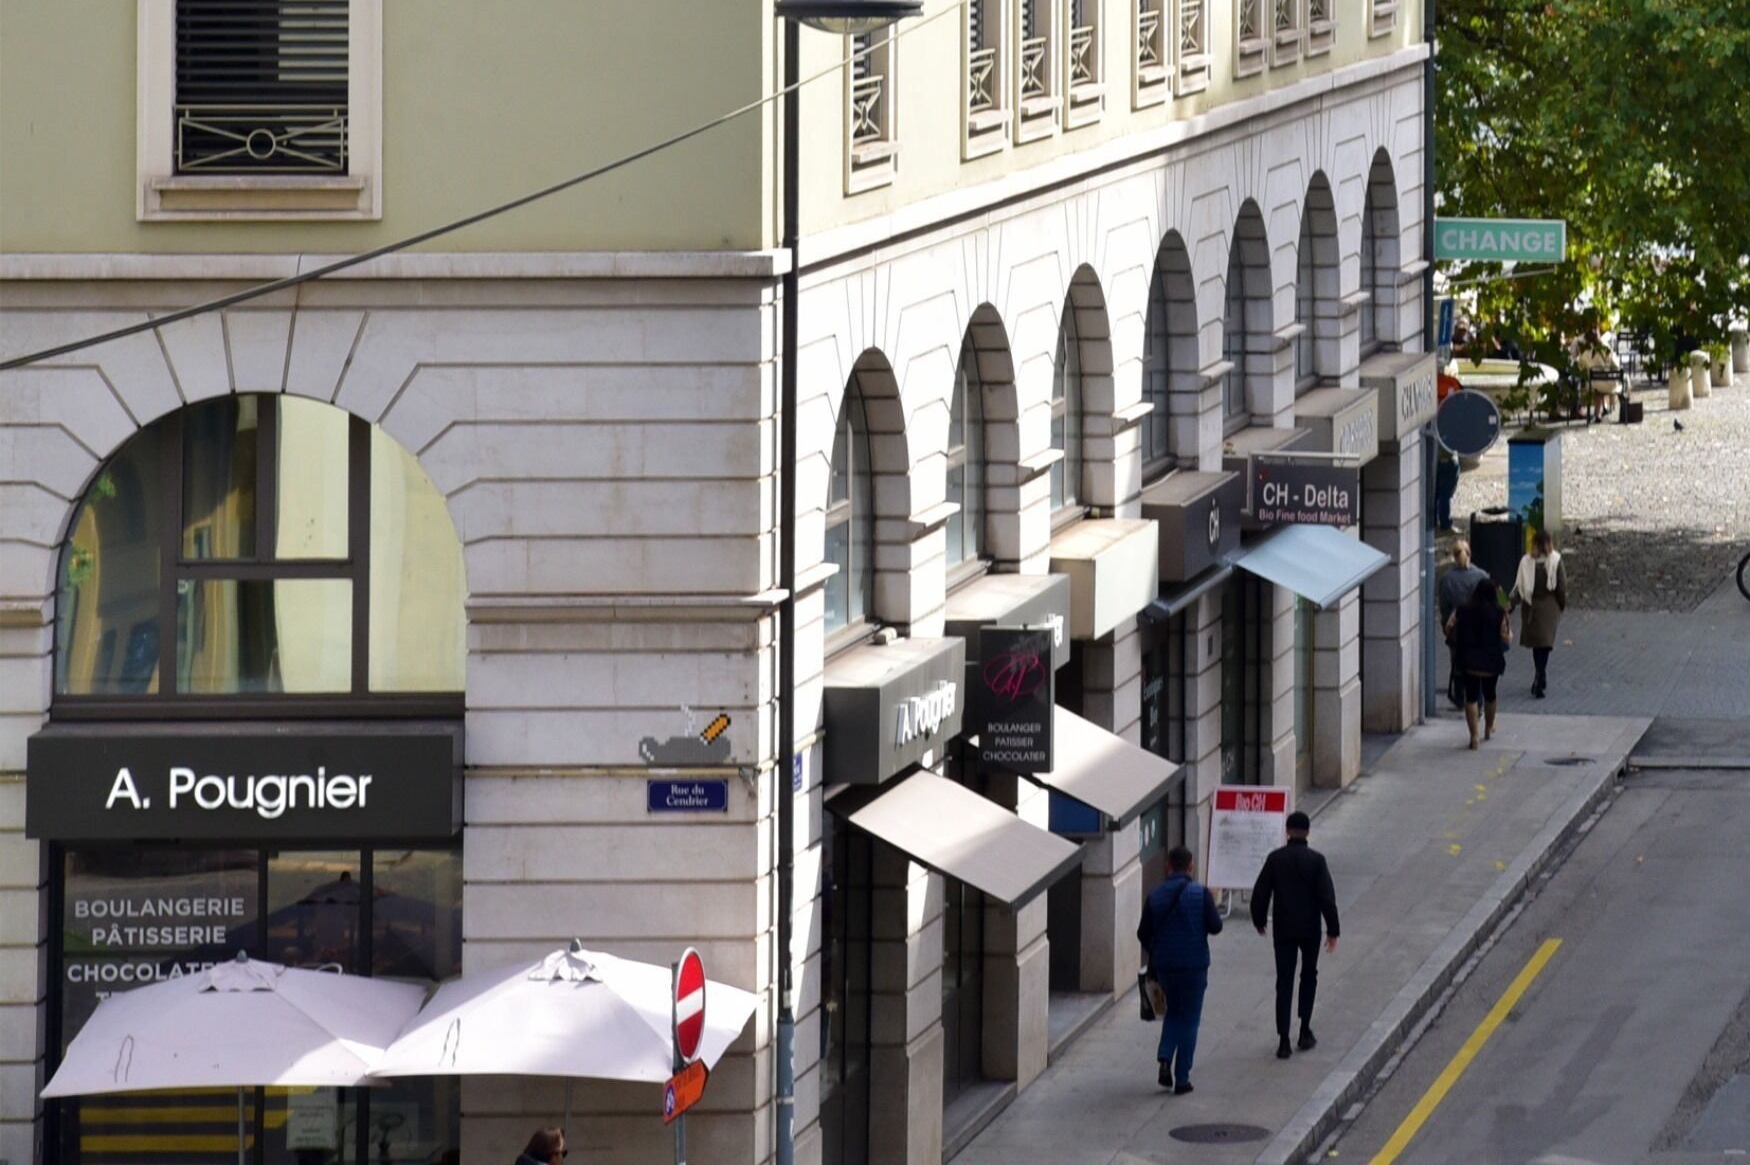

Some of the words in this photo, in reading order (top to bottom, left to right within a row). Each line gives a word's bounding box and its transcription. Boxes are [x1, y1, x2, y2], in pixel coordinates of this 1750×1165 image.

[1441, 228, 1556, 253] CHANGE
[1262, 482, 1289, 506] CH
[1304, 483, 1349, 509] Delta
[1259, 508, 1275, 521] Bio
[1276, 509, 1296, 522] Fine
[1297, 509, 1318, 523] food
[1319, 510, 1351, 525] Market
[987, 722, 1042, 734] BOULANGER
[982, 750, 1046, 762] CHOCOLATIER
[105, 767, 150, 810] A.
[169, 766, 373, 819] Pougnier
[671, 784, 689, 795] Rue
[692, 784, 704, 795] du
[666, 796, 708, 806] Cendrier
[74, 897, 245, 919] BOULANGERIE
[91, 923, 227, 946] PÂTISSERIE
